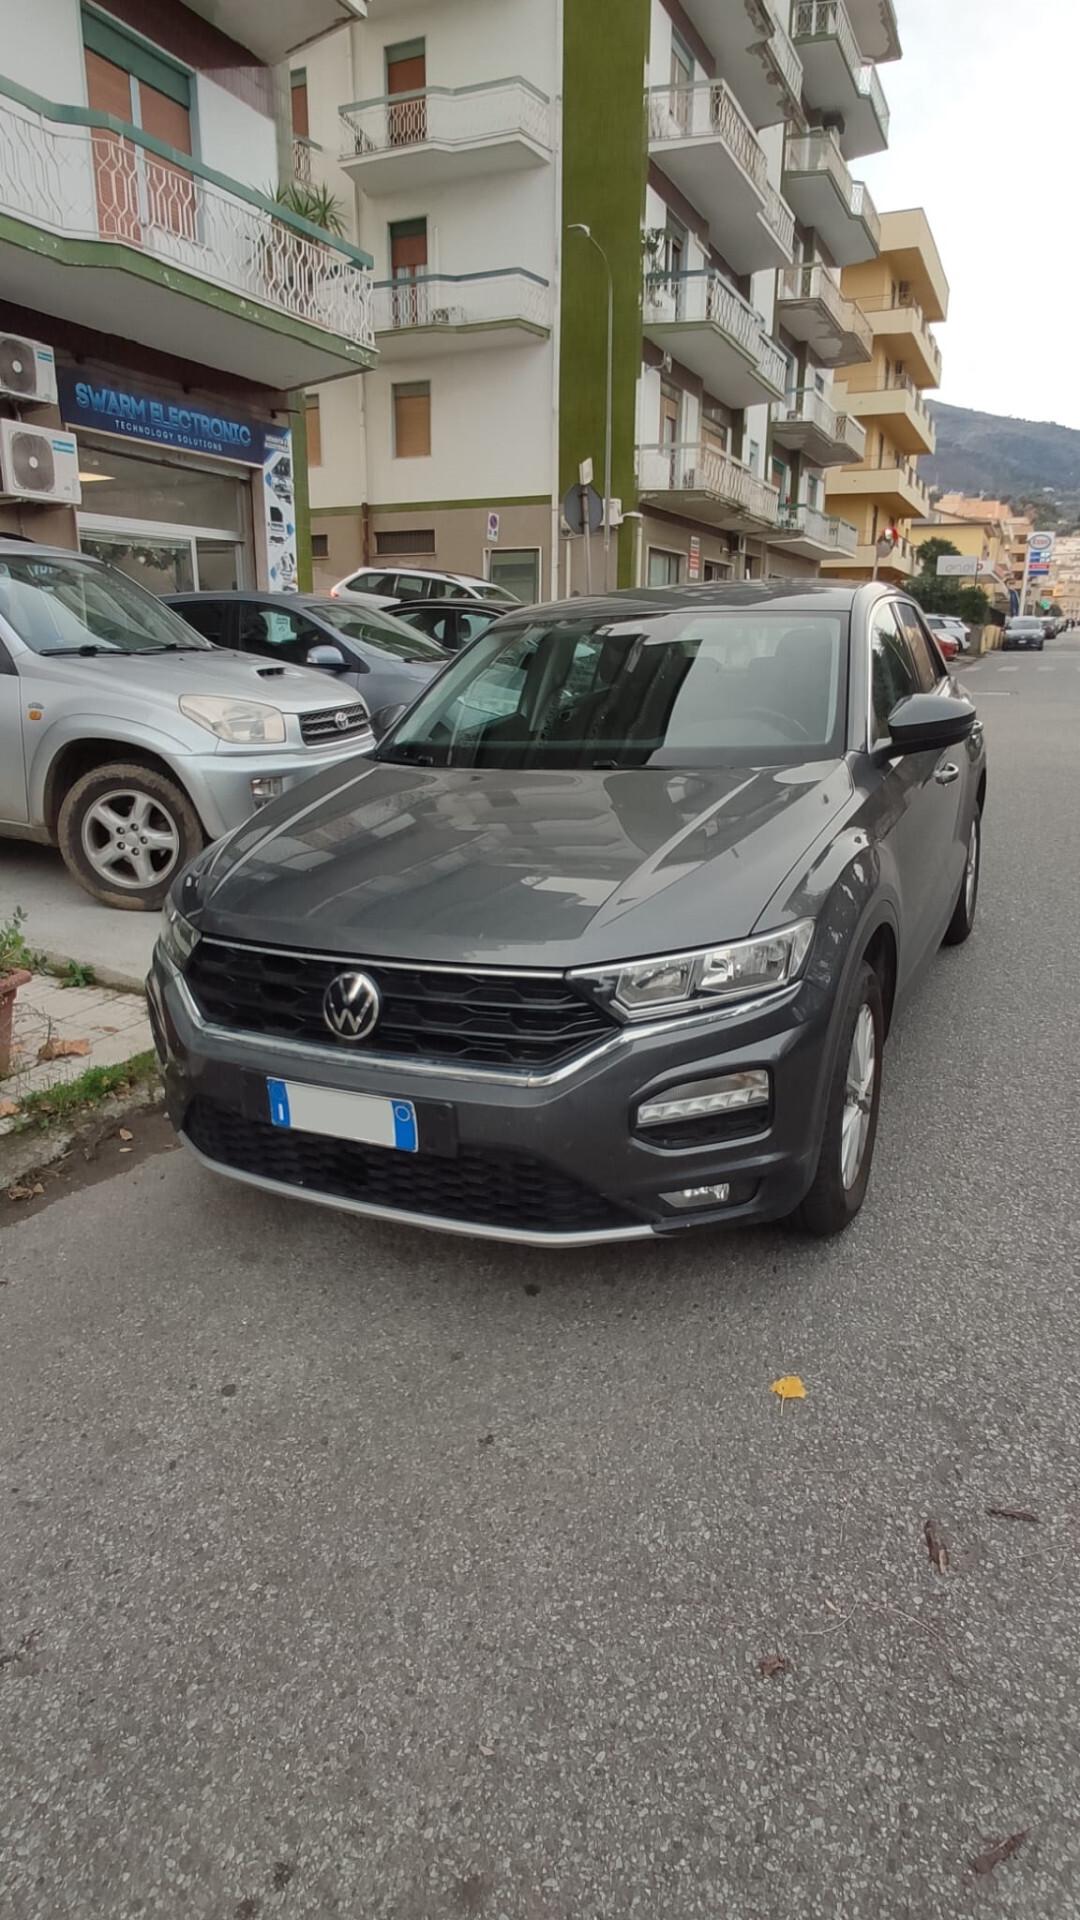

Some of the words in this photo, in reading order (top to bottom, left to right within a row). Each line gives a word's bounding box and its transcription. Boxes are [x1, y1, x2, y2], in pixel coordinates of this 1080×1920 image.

[75, 382, 145, 420] SWARM
[150, 401, 251, 446] ELECTRONIC
[115, 419, 174, 440] TECHNOLOGY
[177, 434, 222, 452] SOLUTIONS
